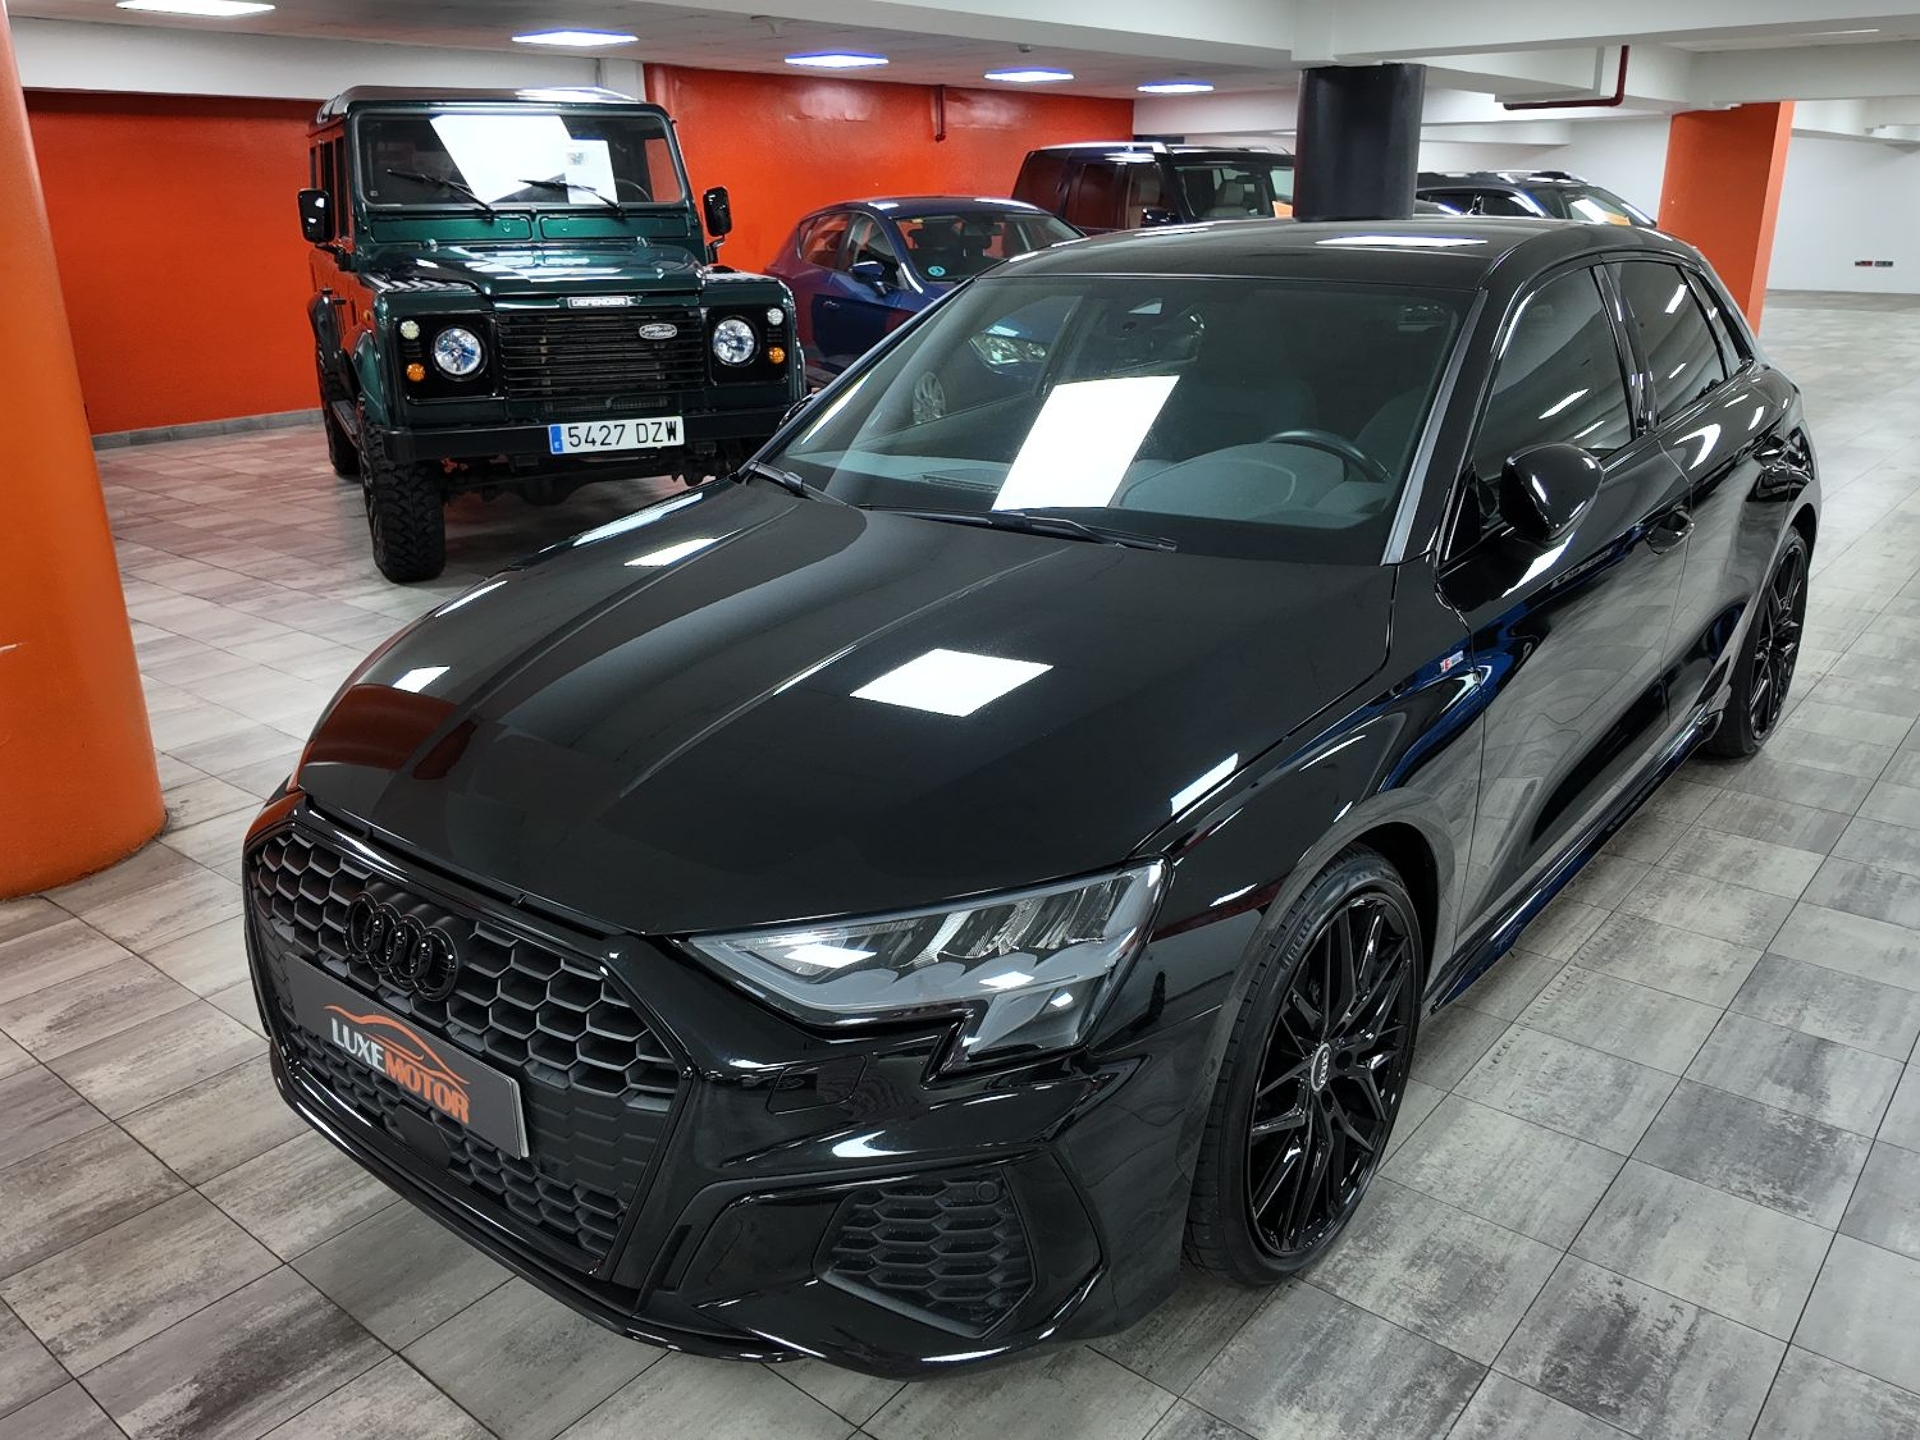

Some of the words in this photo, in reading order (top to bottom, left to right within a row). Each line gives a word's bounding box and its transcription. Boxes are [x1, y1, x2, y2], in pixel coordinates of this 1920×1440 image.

[571, 298, 626, 307] DEFENDER
[568, 424, 625, 448] 5427
[636, 421, 677, 444] DZW
